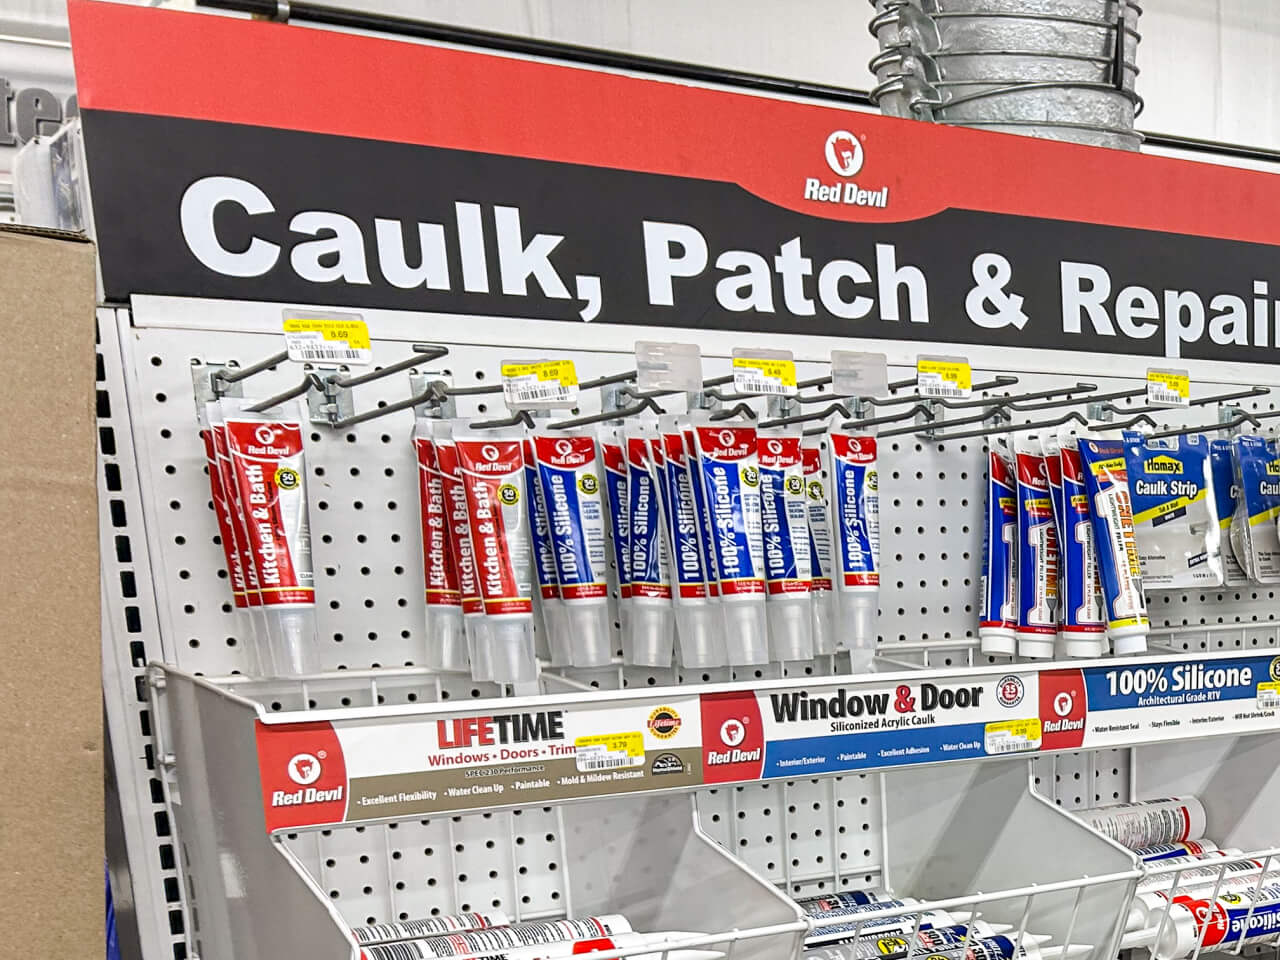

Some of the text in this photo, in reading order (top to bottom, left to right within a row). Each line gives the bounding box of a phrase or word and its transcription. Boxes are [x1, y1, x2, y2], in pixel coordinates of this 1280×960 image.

[804, 177, 887, 208] Red Devil
[180, 176, 601, 321] Caulk,
[642, 220, 929, 324] Patch
[965, 252, 1029, 331] &
[1147, 457, 1180, 473] Homax
[1136, 480, 1197, 499] Caulk Strip
[552, 475, 578, 581] 100% Silicone
[473, 481, 503, 595] Kitchen & Bath
[1106, 666, 1252, 696] 100% Silicone
[770, 683, 984, 723] Window & Door
[1138, 691, 1220, 707] Architectural Grade RTV
[437, 711, 565, 749] LIFETIME
[831, 714, 936, 733] Siliconized Acrylic Caulk
[1045, 718, 1084, 733] Red Devil
[428, 743, 577, 767] Windows Doors Trim
[708, 747, 760, 765] Red Devil
[516, 778, 550, 791] Paintable
[561, 774, 579, 787] Mold
[587, 772, 613, 785] Mildew
[615, 769, 645, 782] Resistant
[272, 785, 343, 807] Red Devil
[362, 788, 437, 806] Excellent Flexibility
[448, 782, 504, 797] Water Clean Up
